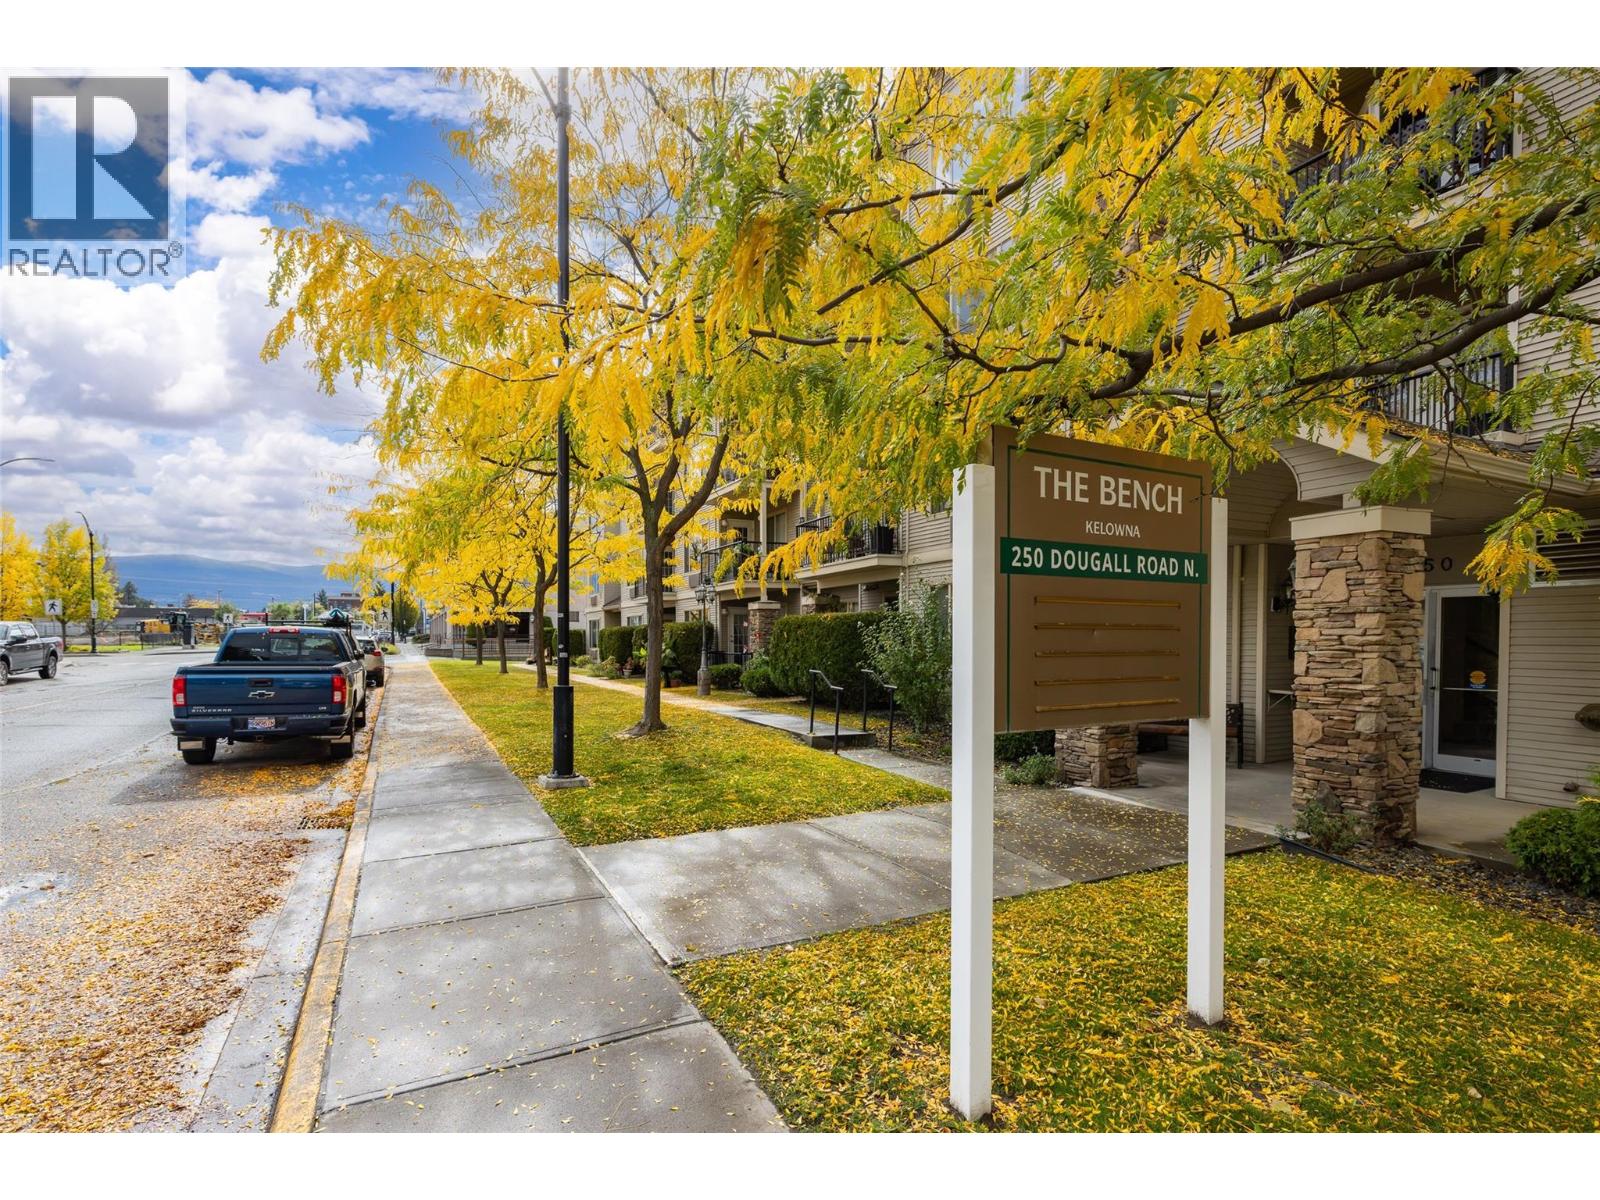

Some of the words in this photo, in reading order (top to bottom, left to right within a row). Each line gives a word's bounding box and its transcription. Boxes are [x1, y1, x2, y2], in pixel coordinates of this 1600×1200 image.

[1033, 466, 1089, 503] THE
[1100, 475, 1183, 514] BENCH
[1085, 520, 1141, 538] KELOWNA
[1011, 546, 1043, 568] 250
[1050, 549, 1131, 573] DOUGALL
[1137, 556, 1179, 576] ROAD
[1184, 559, 1199, 578] N.
